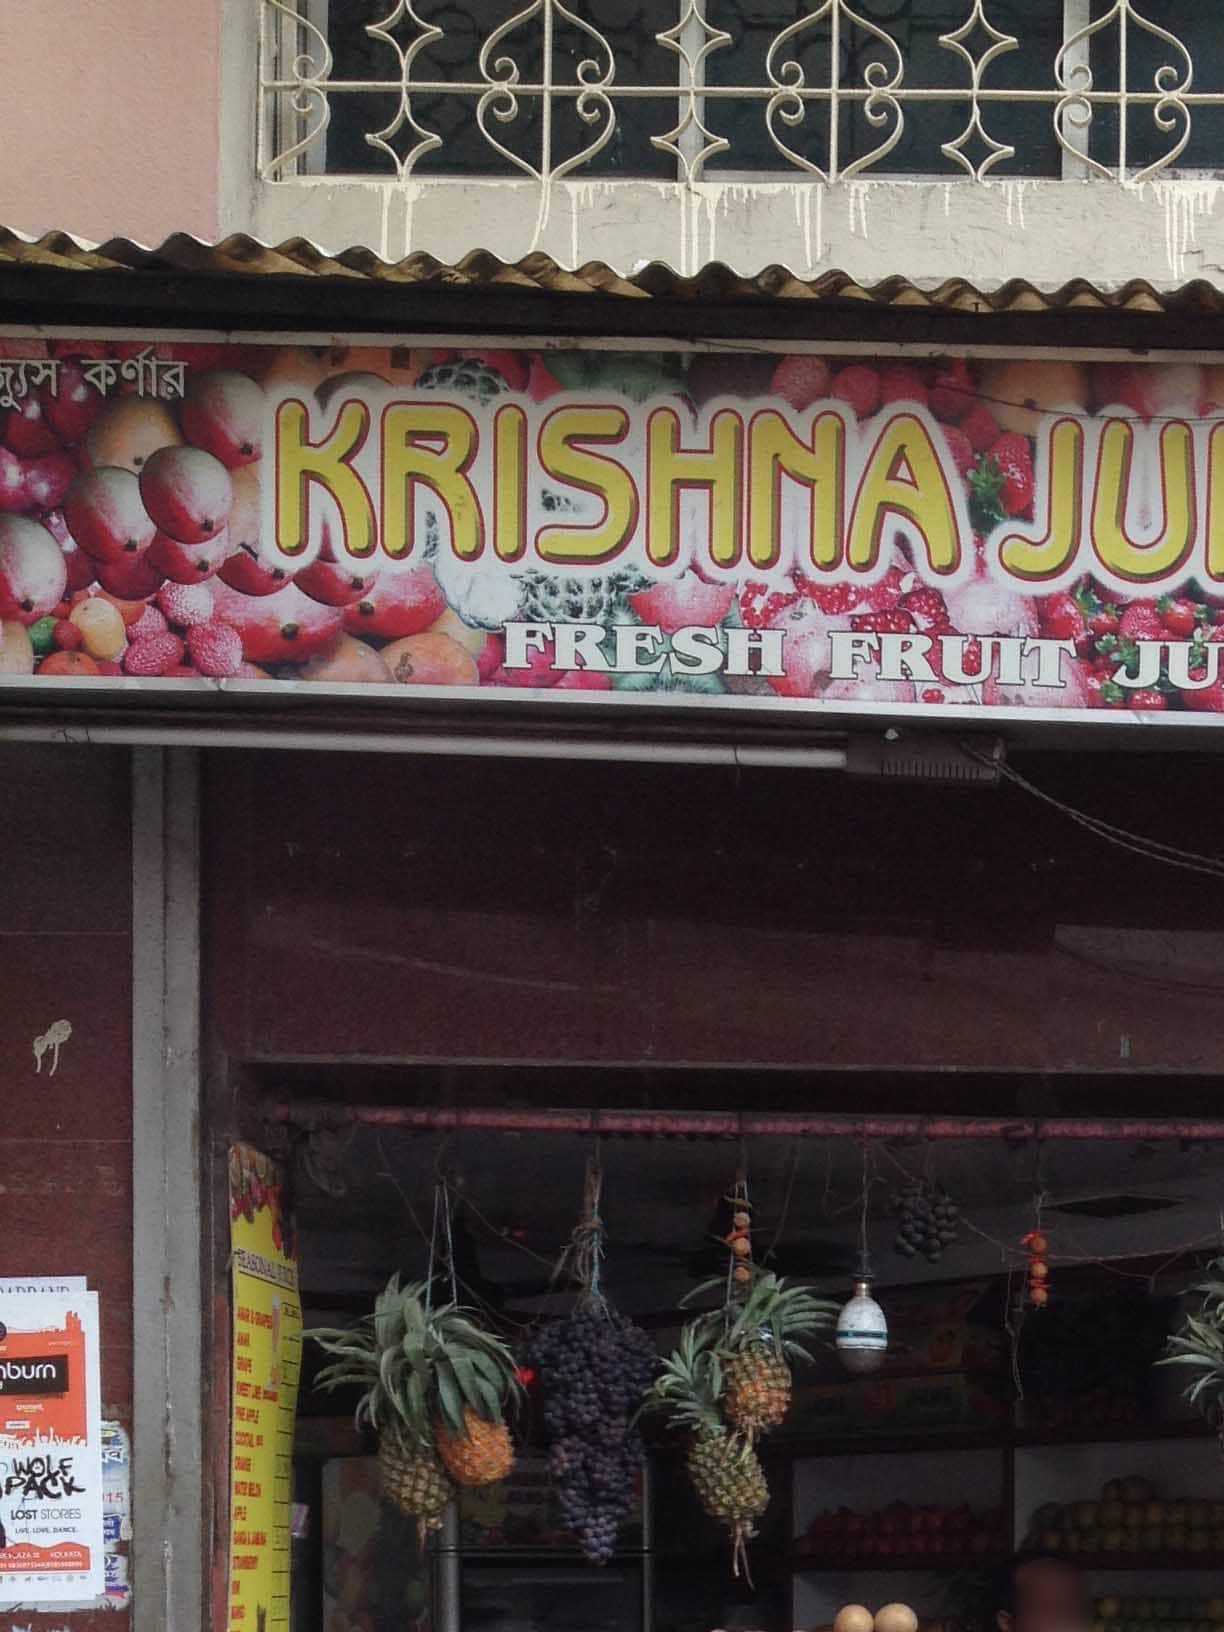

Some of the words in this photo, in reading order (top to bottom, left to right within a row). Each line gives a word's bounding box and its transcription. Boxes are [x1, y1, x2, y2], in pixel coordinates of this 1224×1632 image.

[80, 345, 189, 398] কর্ণার
[275, 399, 961, 576] KRISHNA
[502, 621, 786, 677] FRESH
[828, 630, 1077, 688] FRUIT
[13, 1455, 73, 1476] WOLF
[5, 1474, 86, 1500] PACK
[11, 1509, 37, 1520] LOST
[40, 1508, 81, 1519] STORIES
